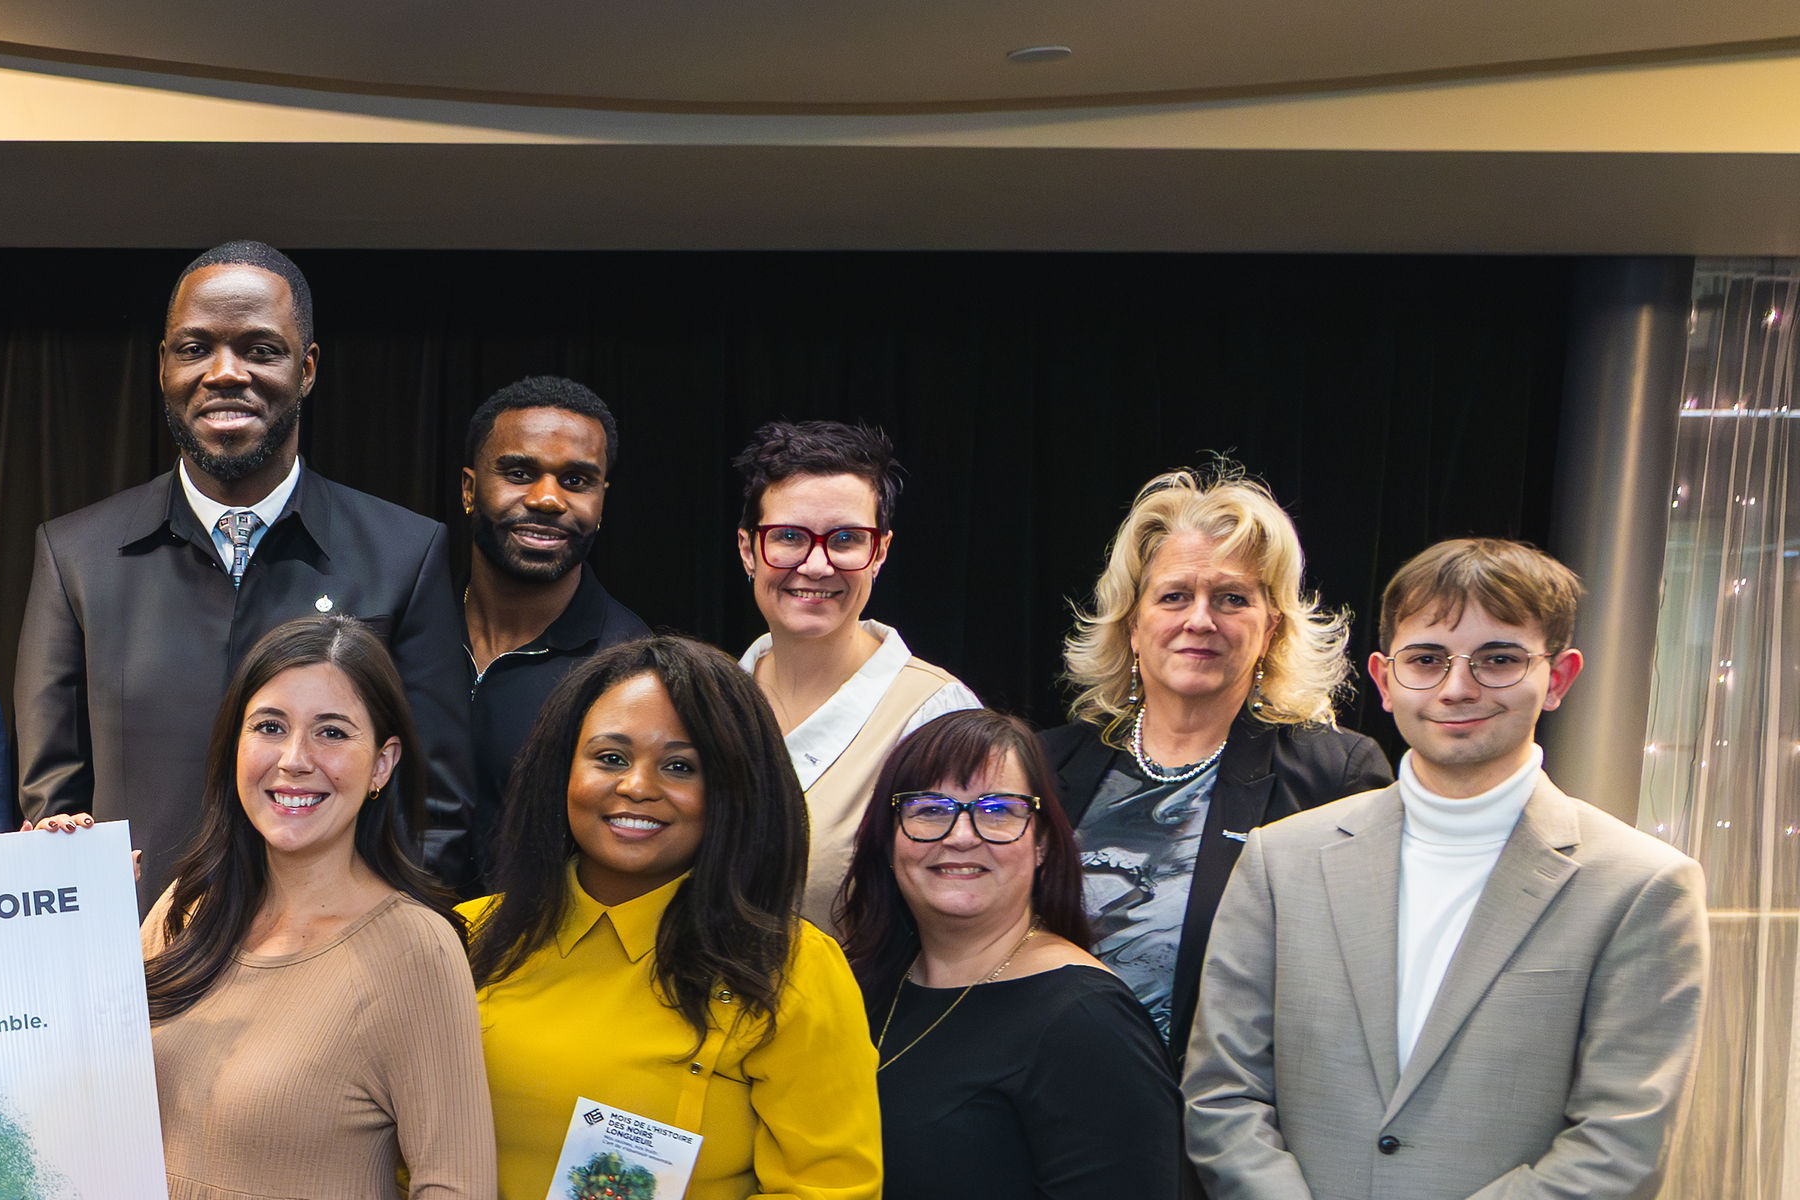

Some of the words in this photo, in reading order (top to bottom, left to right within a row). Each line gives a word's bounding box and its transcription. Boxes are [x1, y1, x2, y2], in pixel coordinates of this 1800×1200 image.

[608, 1120, 625, 1130] DES
[626, 1125, 654, 1139] NOIRS
[610, 1113, 632, 1125] MOIS
[633, 1120, 646, 1129] DE
[606, 1127, 654, 1147] LONGUEUIL
